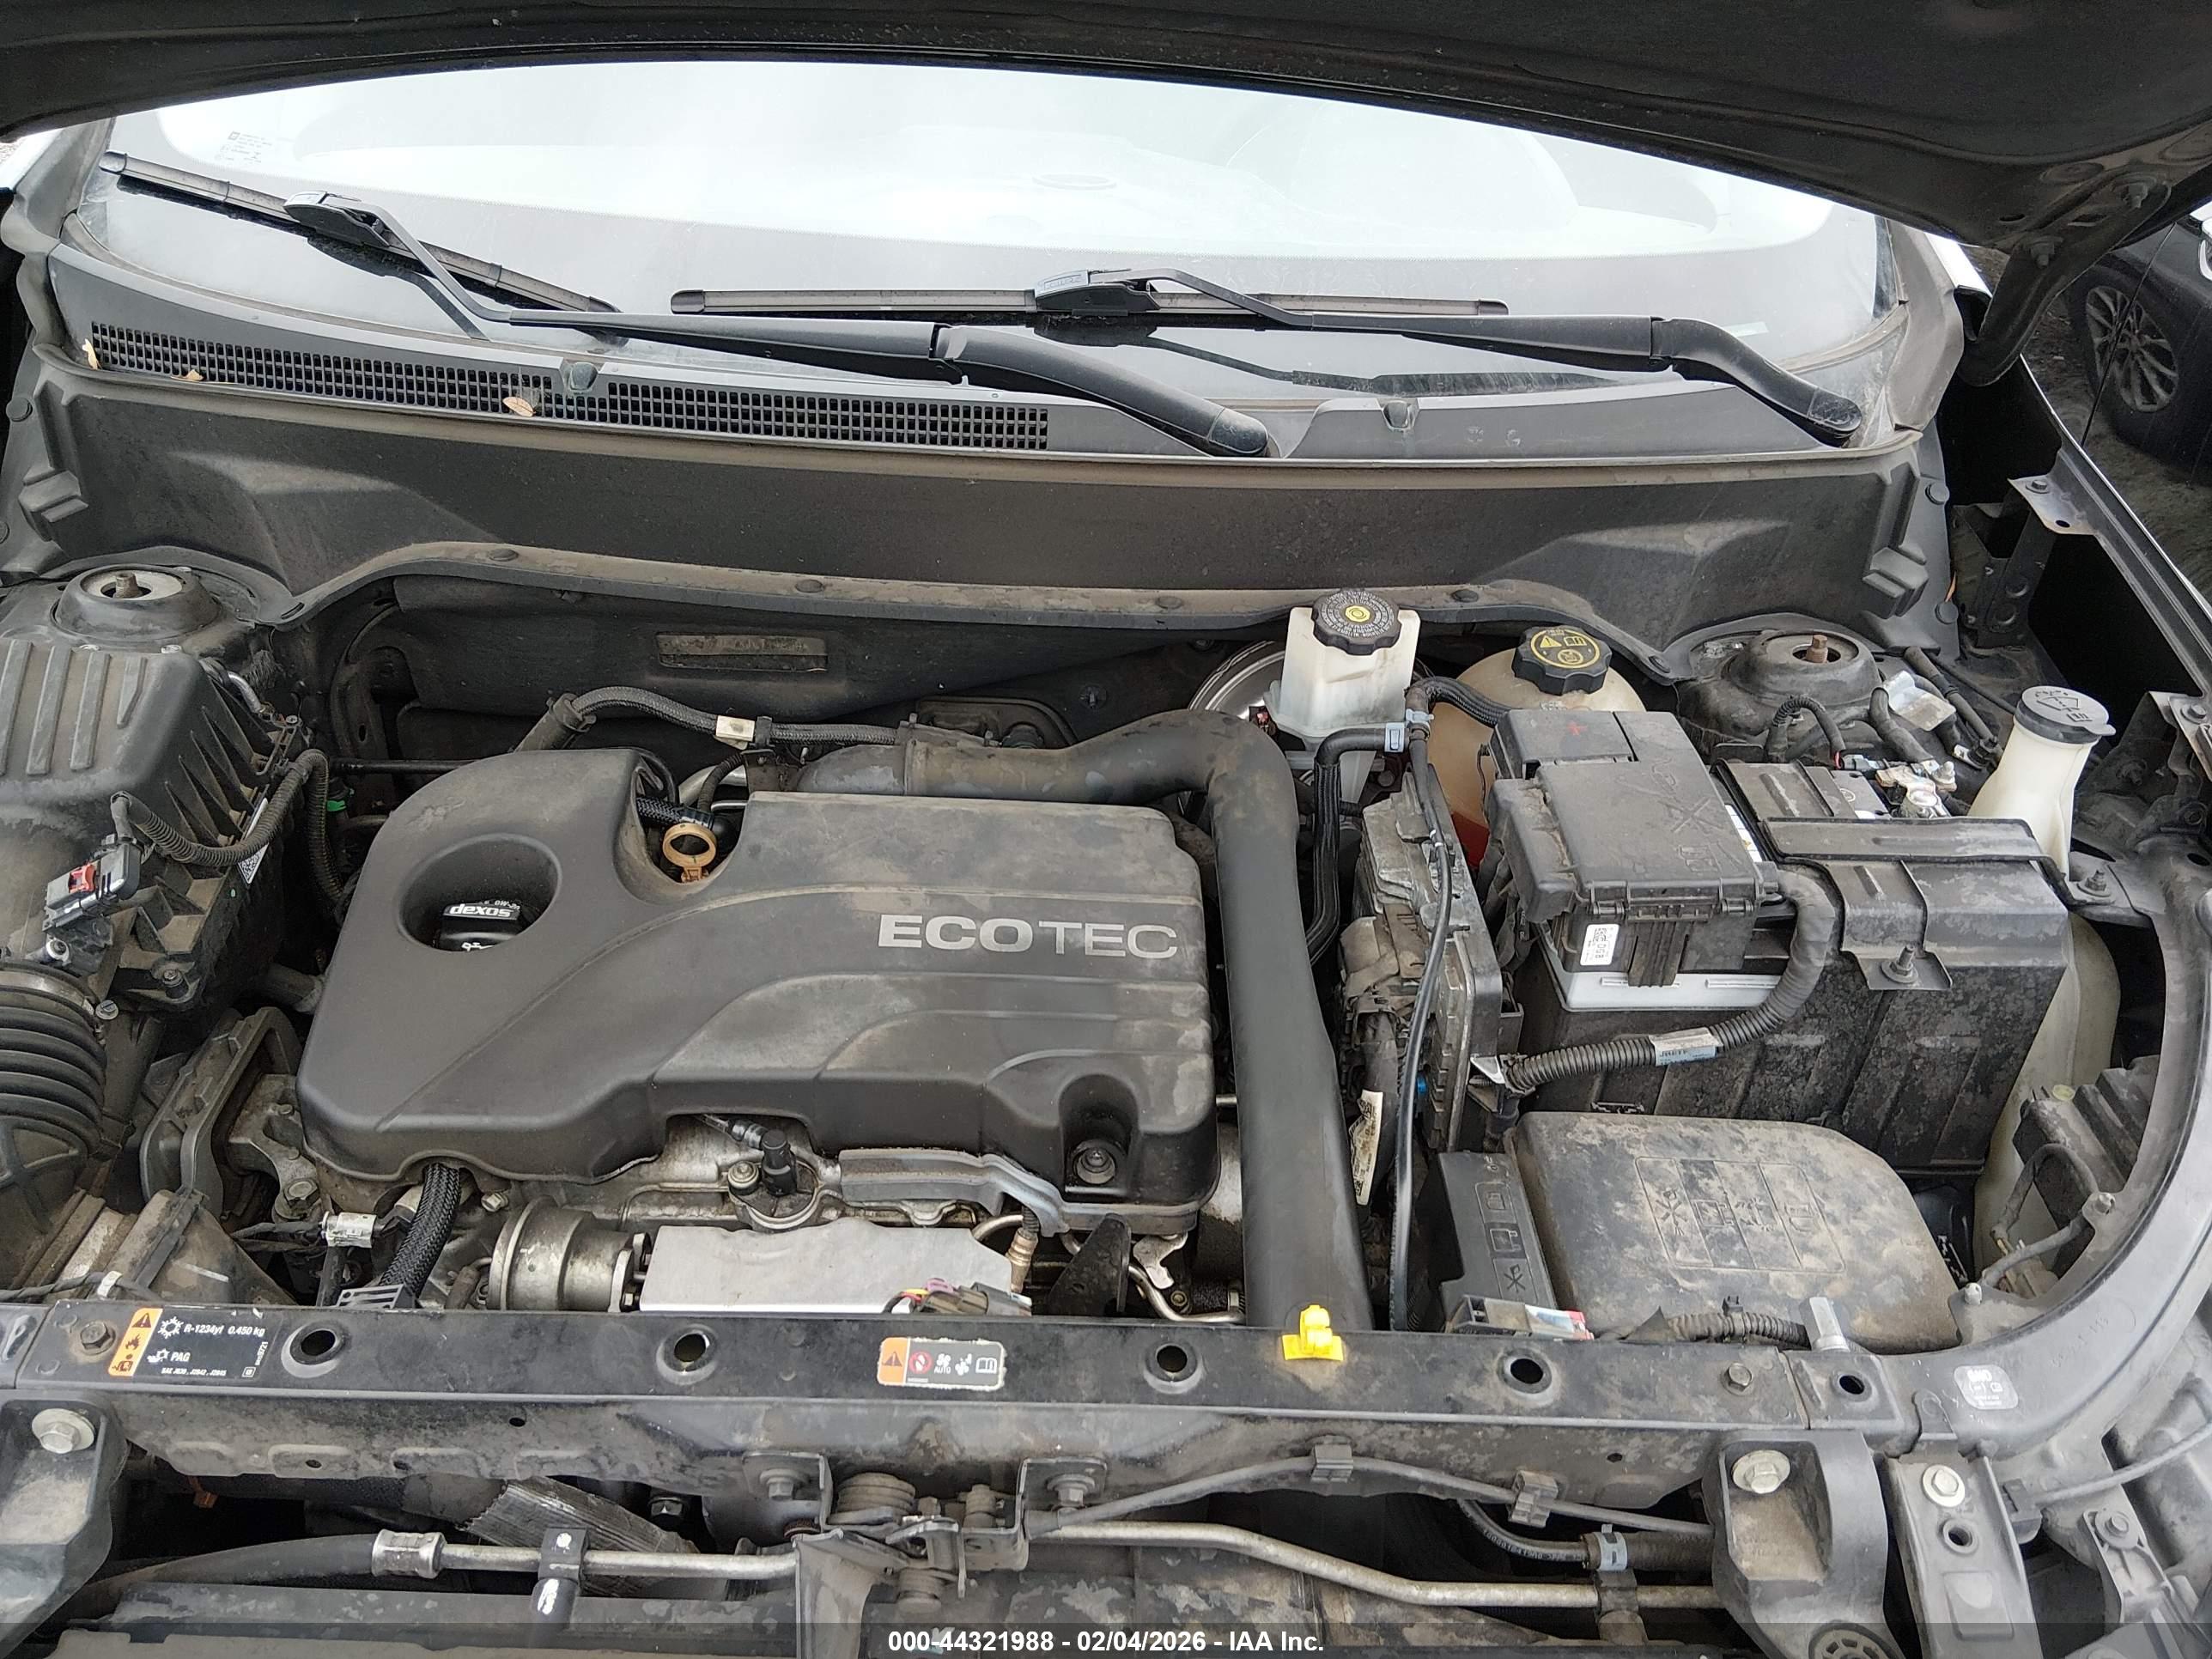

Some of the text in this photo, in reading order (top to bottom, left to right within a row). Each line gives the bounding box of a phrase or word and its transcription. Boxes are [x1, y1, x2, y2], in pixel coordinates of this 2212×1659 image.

[449, 903, 514, 918] dexos
[878, 914, 1178, 959] ECOTEC
[228, 1325, 253, 1335] 0.450
[252, 1327, 265, 1337] kg
[170, 1352, 191, 1363] PAG
